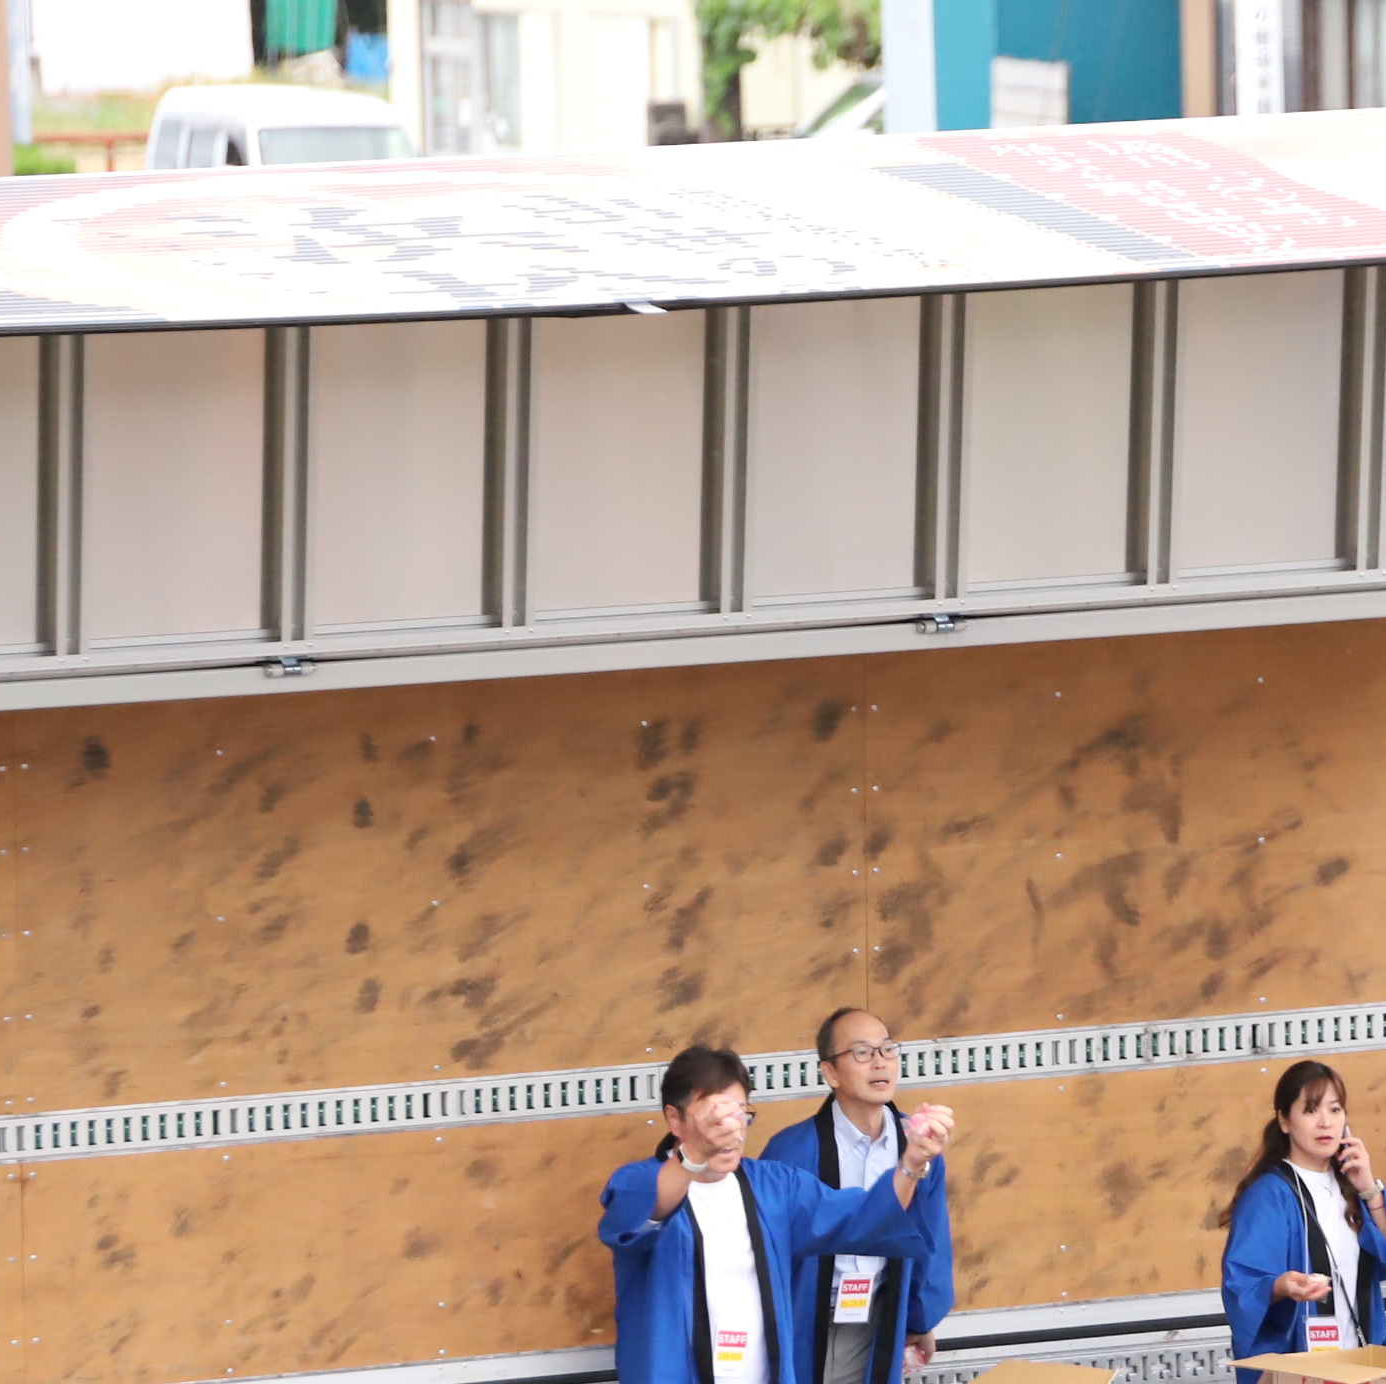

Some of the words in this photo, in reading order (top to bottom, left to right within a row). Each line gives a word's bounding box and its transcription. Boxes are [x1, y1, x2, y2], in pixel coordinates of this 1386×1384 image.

[842, 1283, 869, 1292] STAFF
[717, 1333, 747, 1344] STAFF
[1309, 1330, 1337, 1339] STAFF
